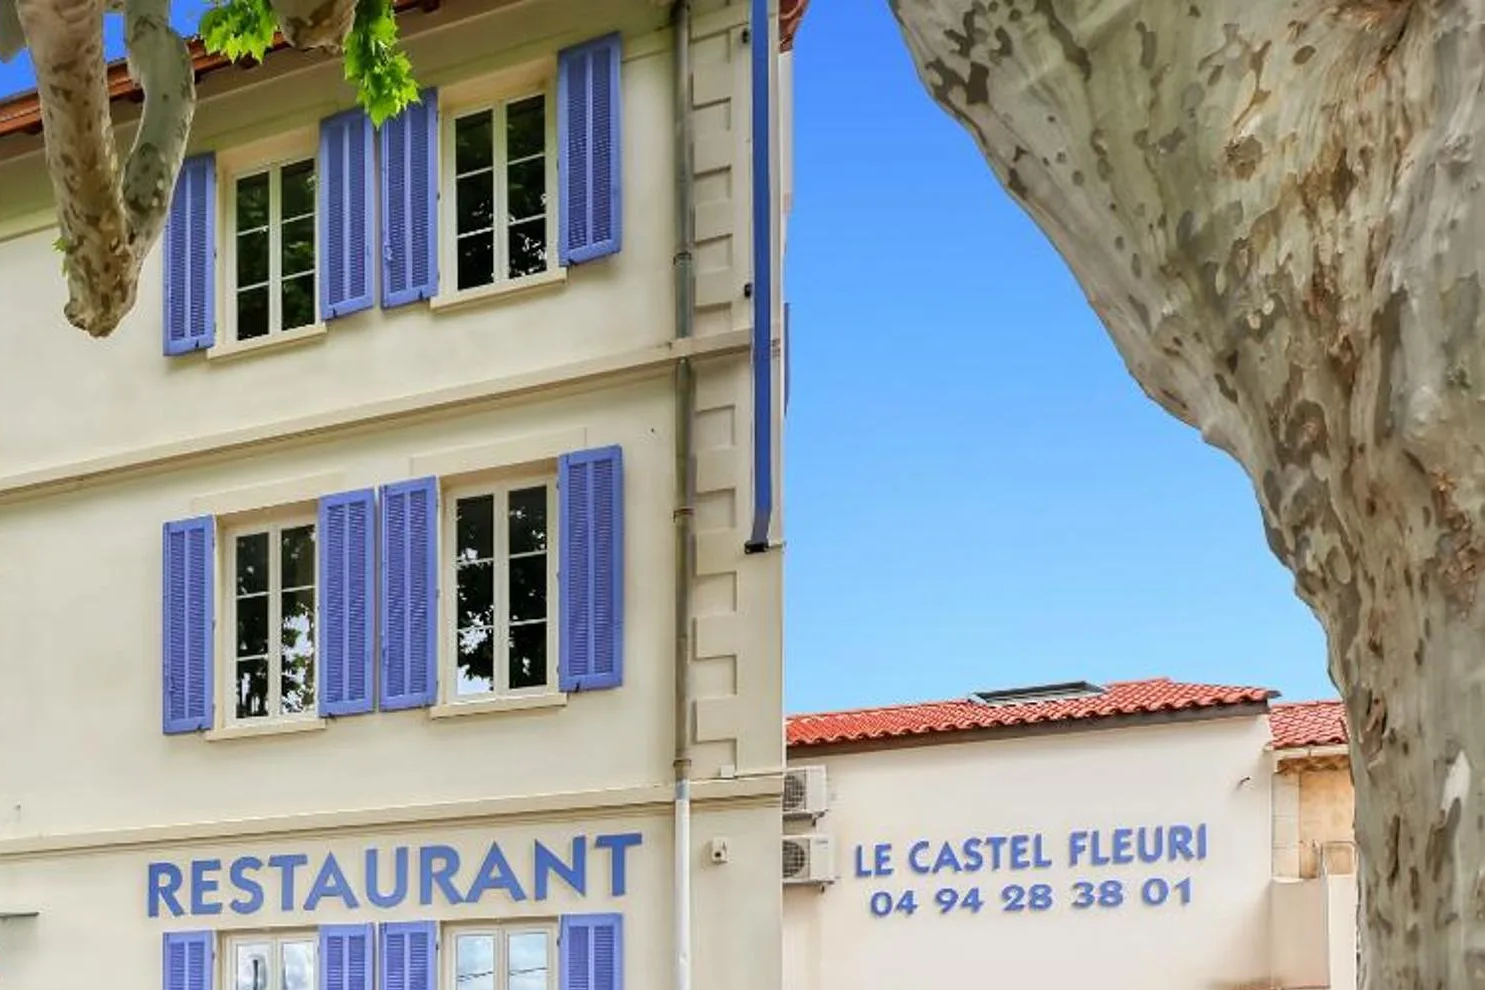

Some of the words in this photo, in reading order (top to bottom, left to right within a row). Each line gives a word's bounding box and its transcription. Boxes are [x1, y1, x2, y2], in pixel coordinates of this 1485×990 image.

[147, 832, 643, 919] RESTAURANT
[855, 844, 895, 878] LE
[908, 832, 1053, 876] CASTEL
[1068, 822, 1208, 868] FLEURI
[870, 889, 918, 918] 04
[933, 887, 984, 914] 94
[1001, 883, 1053, 912] 28
[1070, 879, 1124, 909] 38
[1140, 876, 1192, 906] 01
